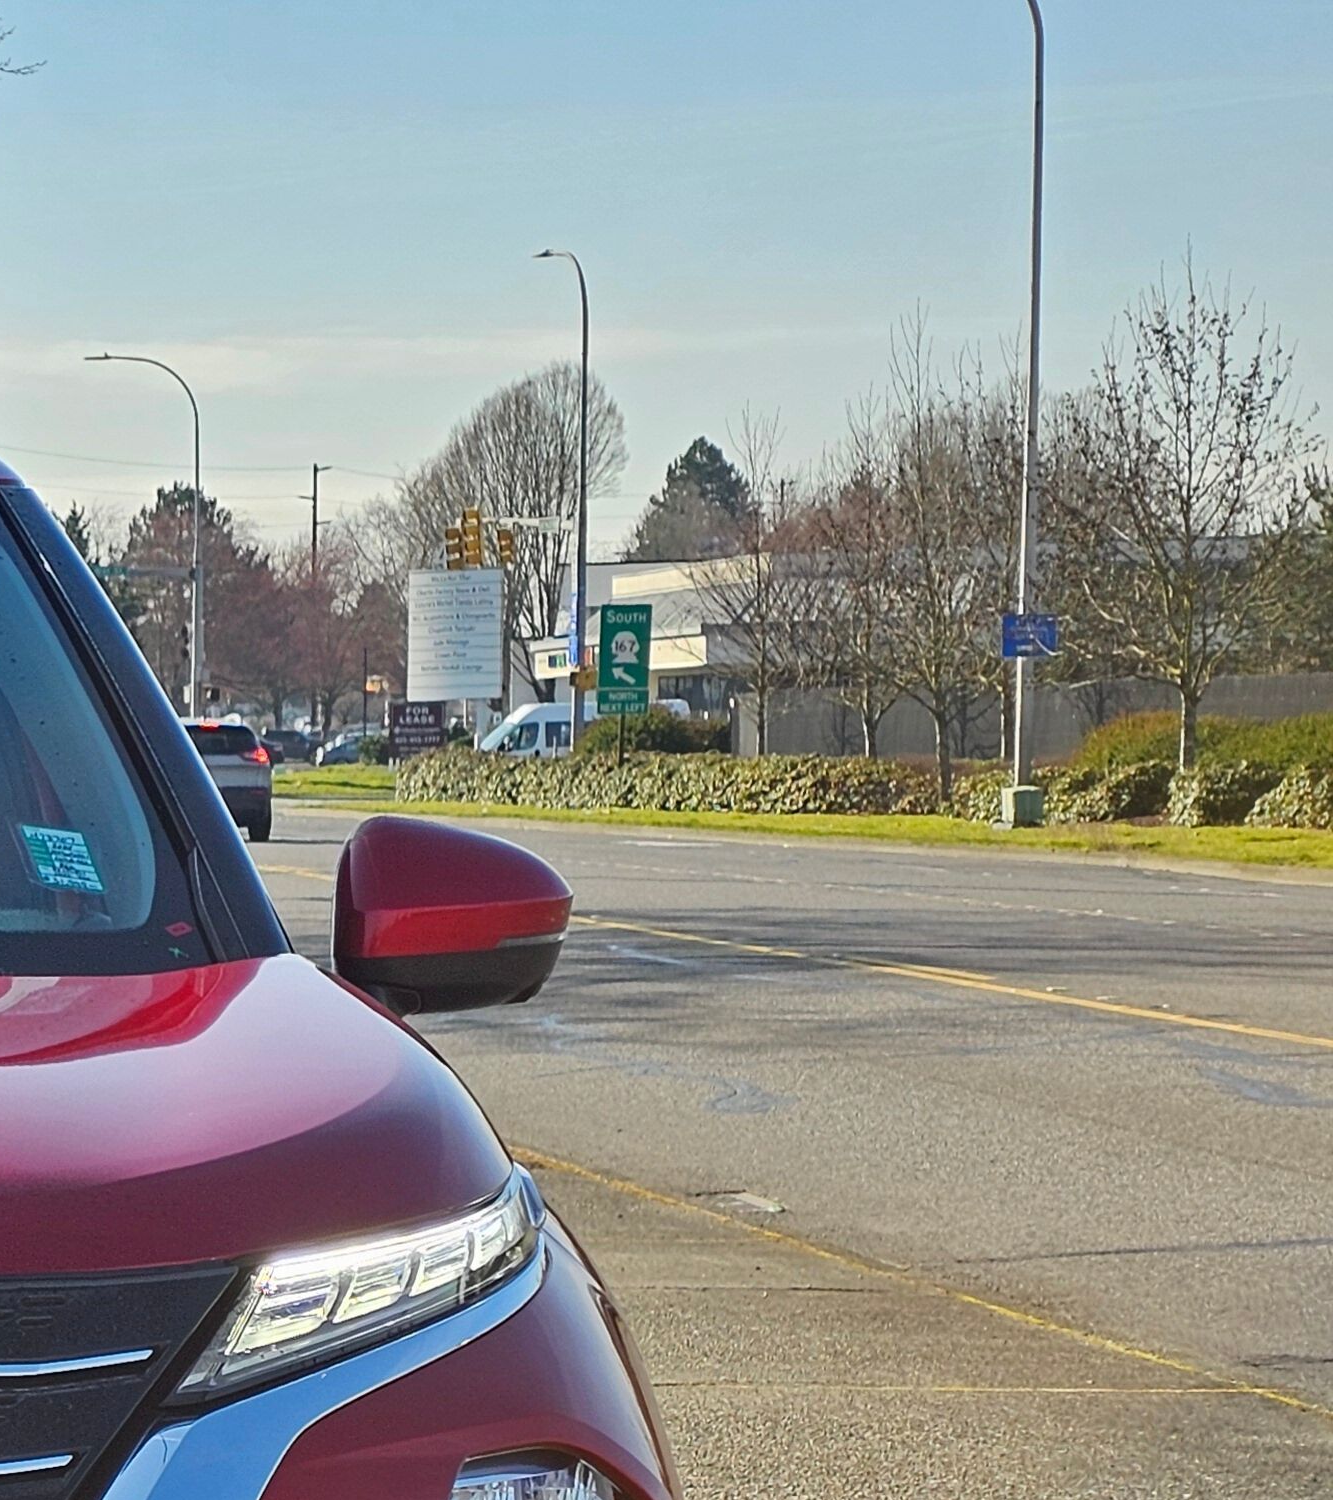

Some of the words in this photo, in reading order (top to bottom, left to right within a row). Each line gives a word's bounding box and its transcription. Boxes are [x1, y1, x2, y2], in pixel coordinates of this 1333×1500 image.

[615, 640, 636, 653] 167
[608, 692, 638, 701] NORTH
[406, 706, 429, 715] FOR
[599, 703, 622, 712] NEXT
[625, 703, 646, 712] LEFT
[399, 715, 435, 725] LEASE
